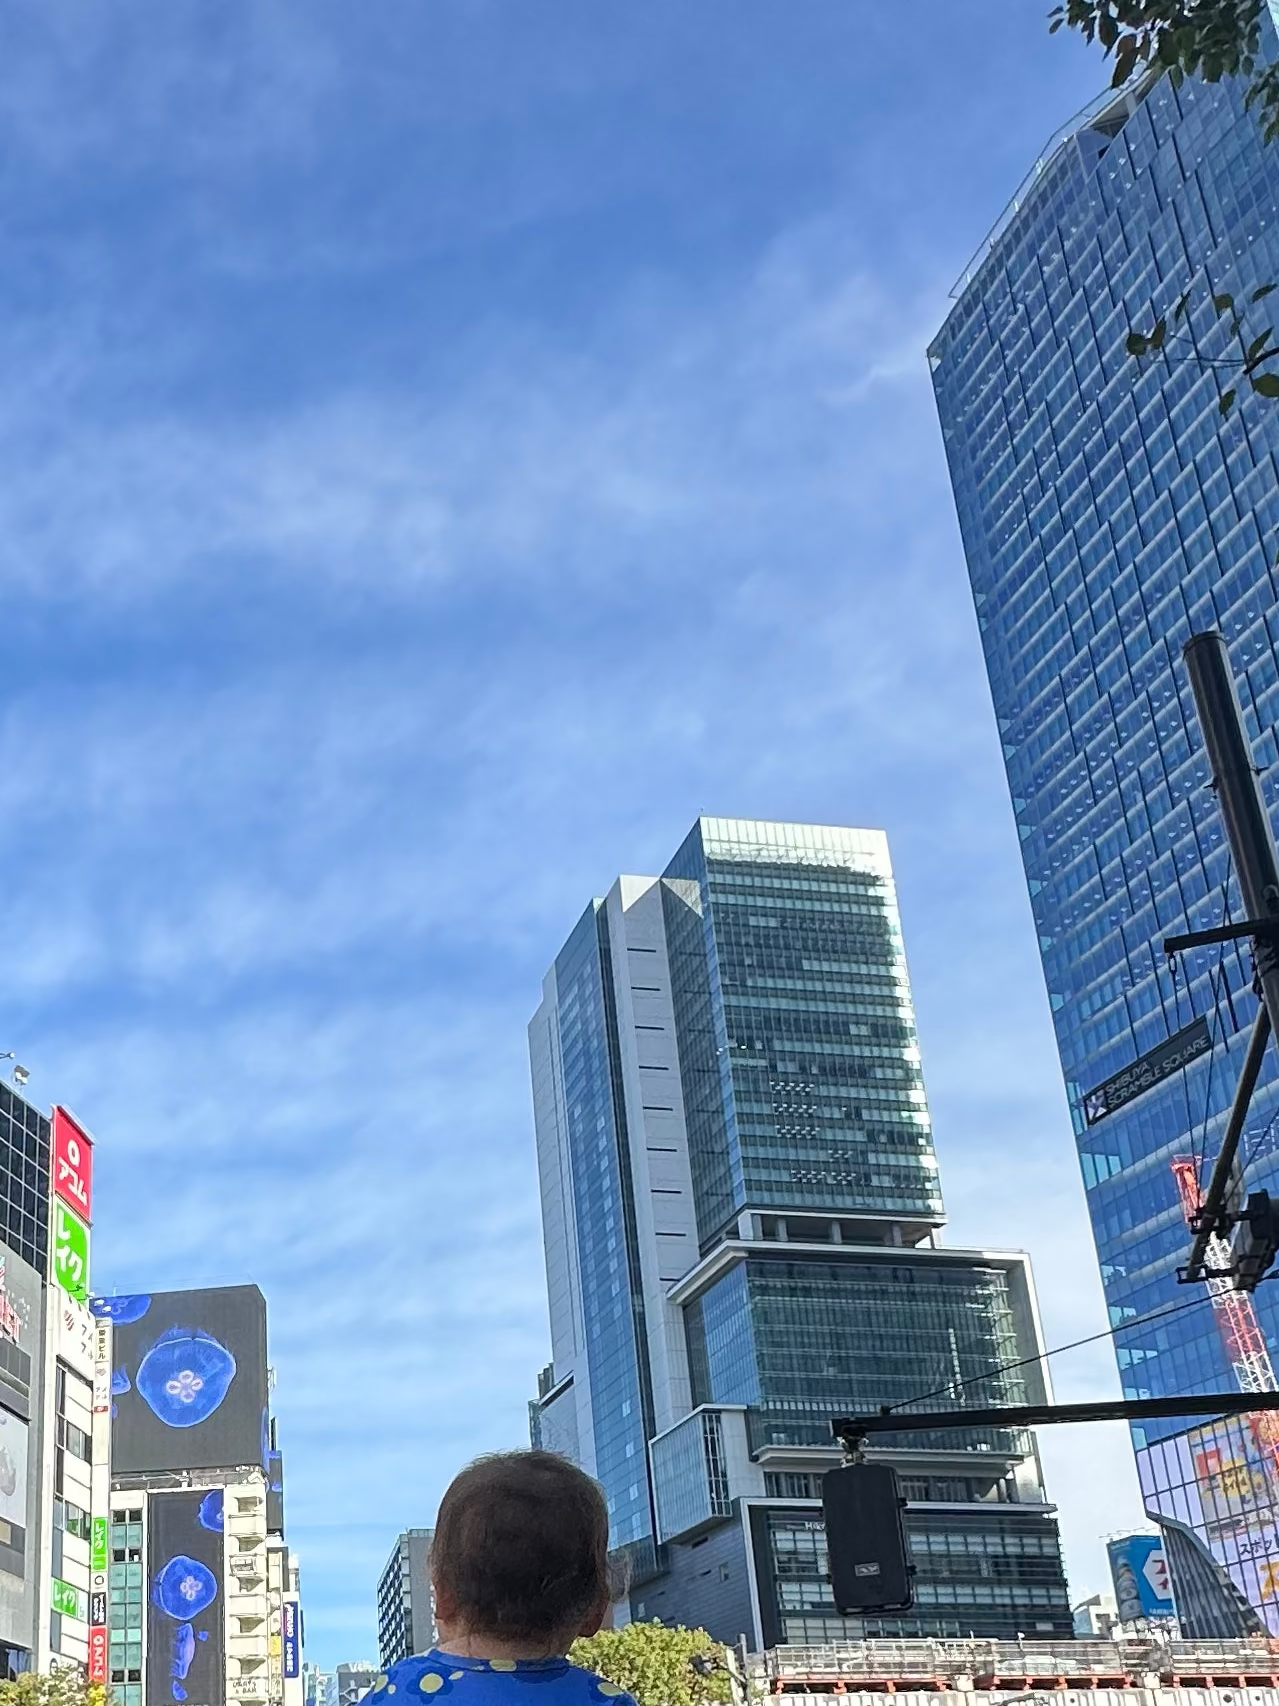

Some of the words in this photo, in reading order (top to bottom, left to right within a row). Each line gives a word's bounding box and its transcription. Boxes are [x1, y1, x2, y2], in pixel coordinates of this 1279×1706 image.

[1104, 1059, 1152, 1096] SHIBUYA
[1107, 1066, 1161, 1109] SCRAMBLE
[1162, 1035, 1210, 1073] SQUARE
[53, 1584, 77, 1612] レイク
